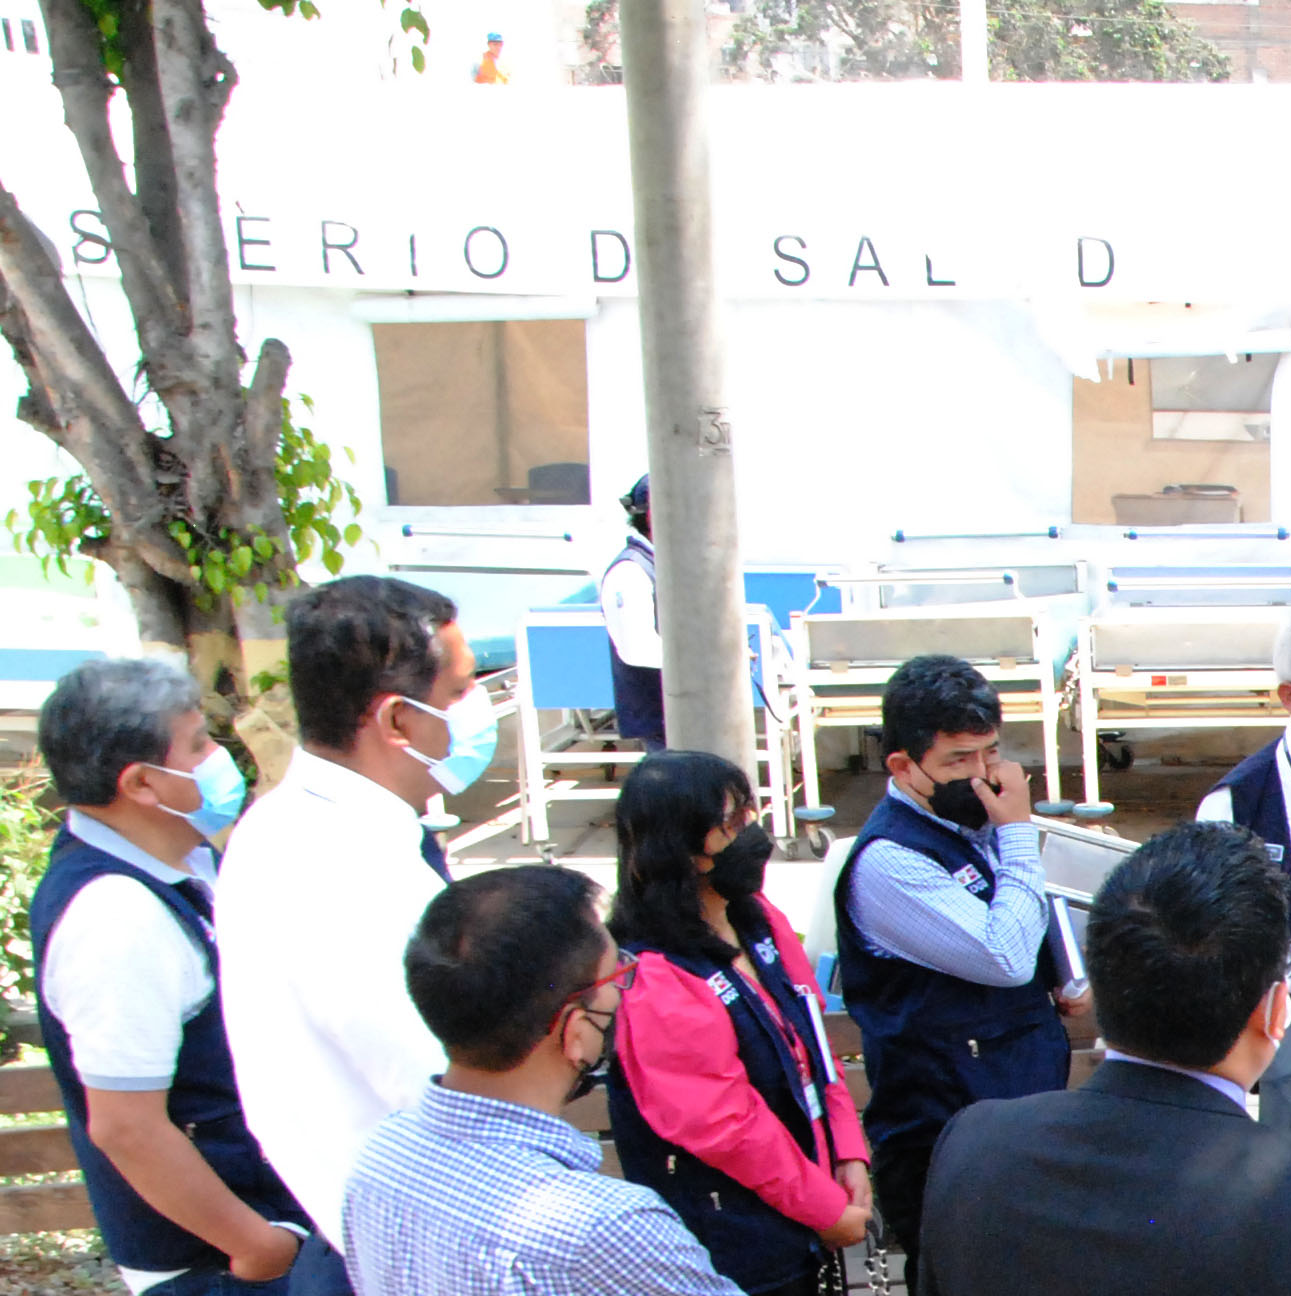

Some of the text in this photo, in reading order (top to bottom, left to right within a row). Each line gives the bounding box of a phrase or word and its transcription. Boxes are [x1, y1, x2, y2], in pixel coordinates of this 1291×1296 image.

[69, 208, 1115, 287] SERIO D SALD
